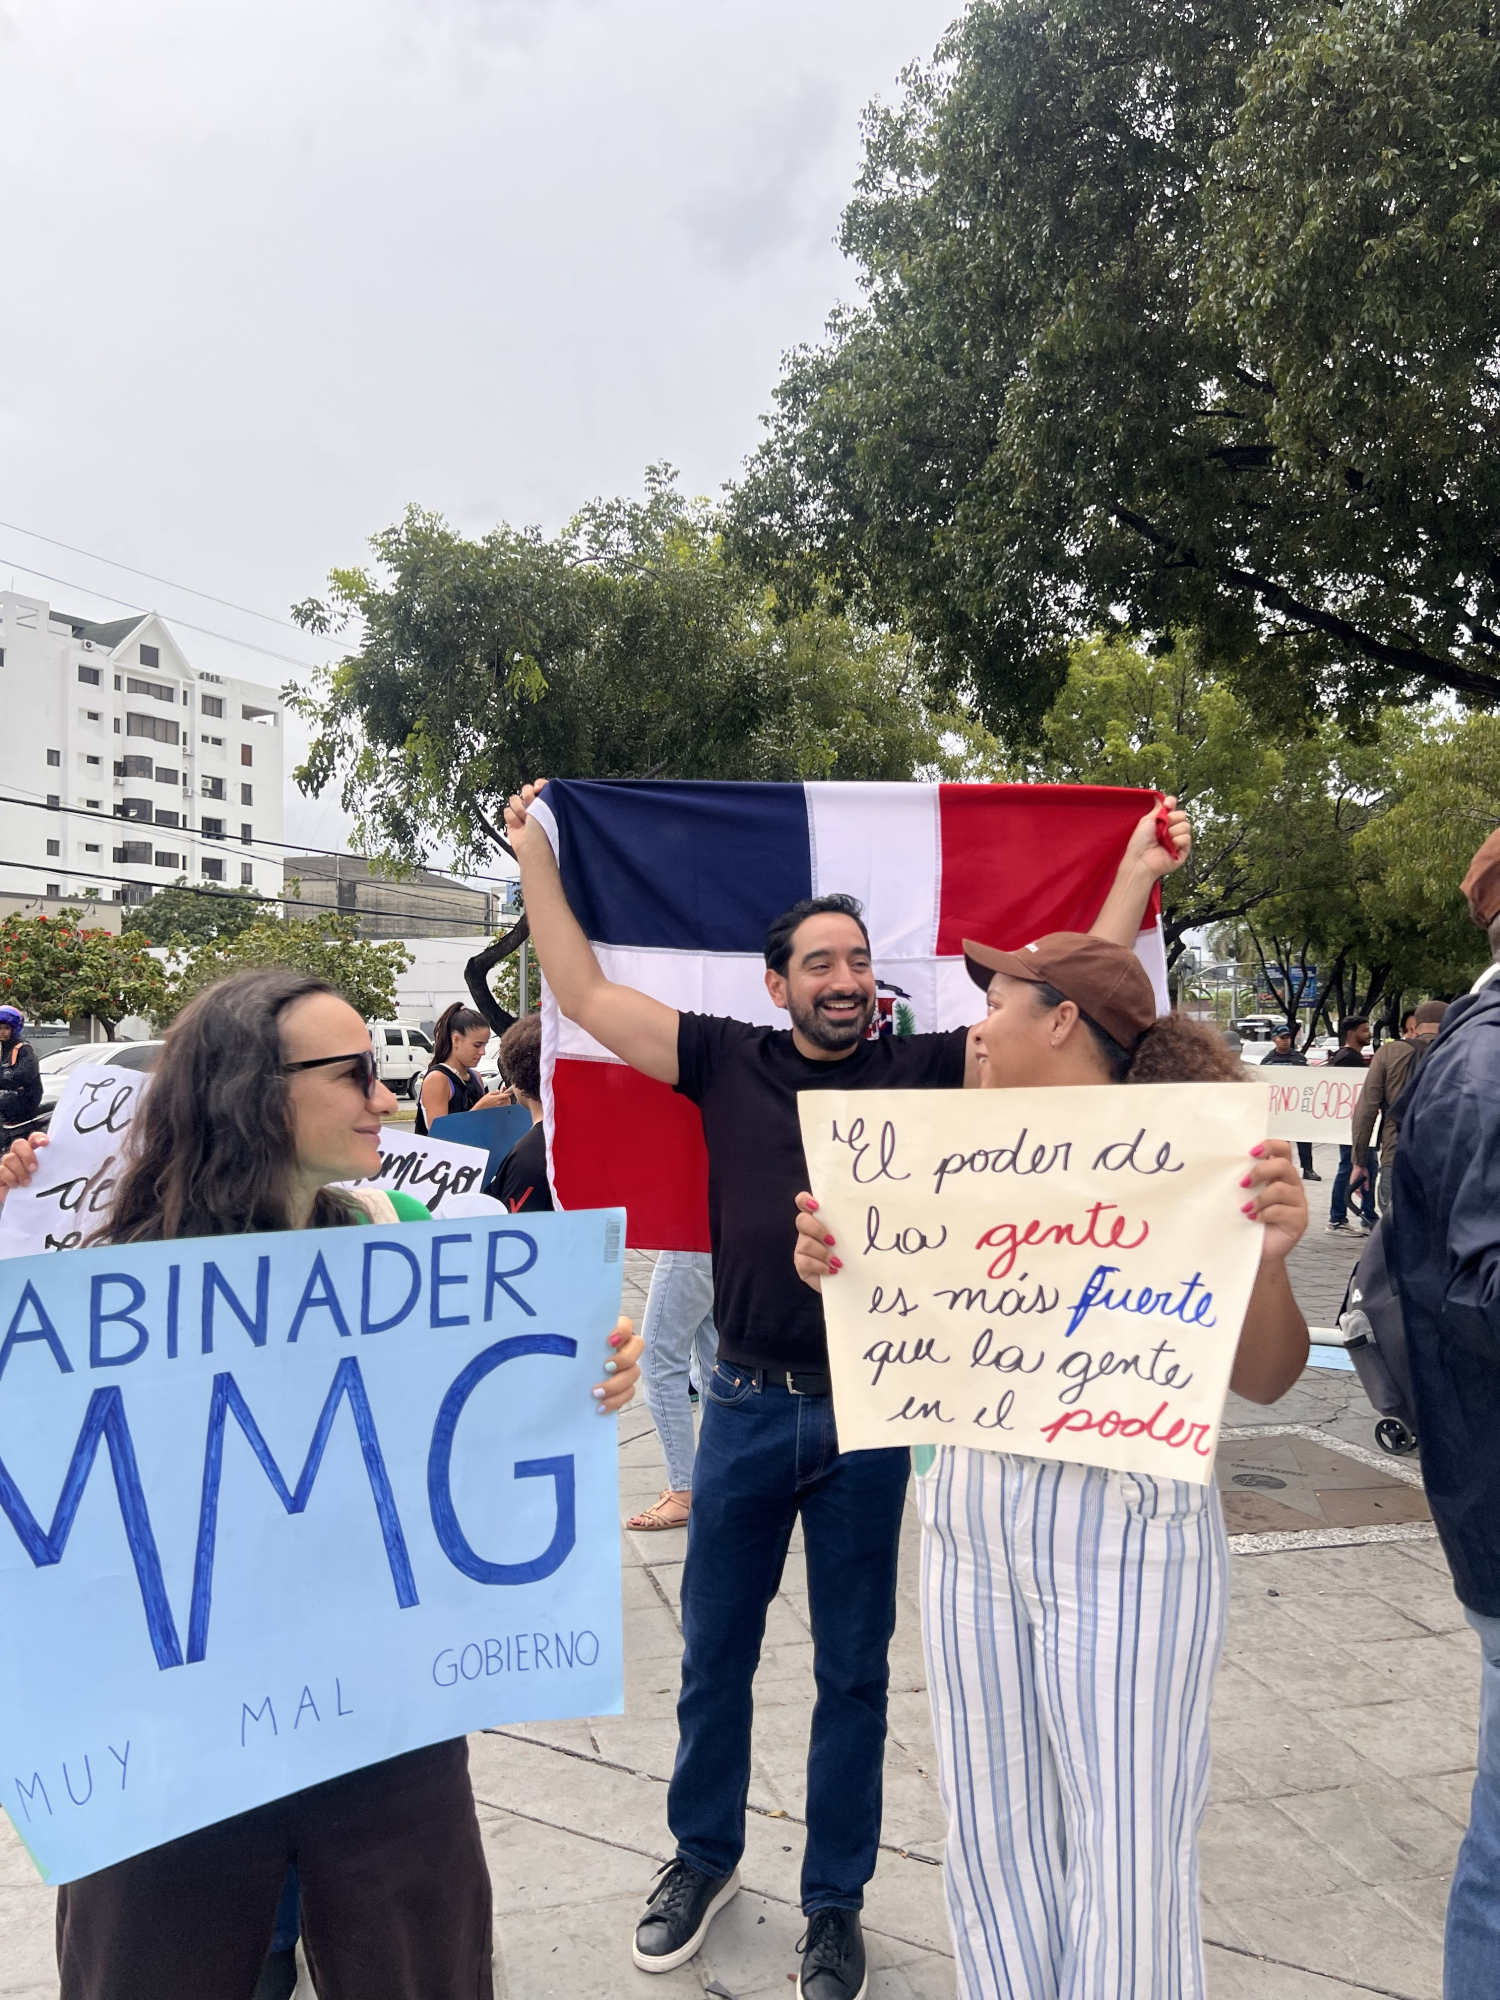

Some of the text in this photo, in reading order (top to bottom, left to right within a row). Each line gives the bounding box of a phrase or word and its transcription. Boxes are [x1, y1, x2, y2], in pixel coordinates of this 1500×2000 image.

[73, 1077, 133, 1134] El
[832, 1117, 1185, 1194] El poder de
[862, 1201, 1149, 1280] la gente
[0, 1229, 539, 1376] ABINADER
[867, 1264, 1217, 1338] es más fuerte
[862, 1328, 1193, 1404] que la gente
[886, 1389, 1211, 1456] en el poder
[0, 1332, 578, 1671] MMG
[14, 1630, 600, 1822] MUY MAL GOBIERNO
